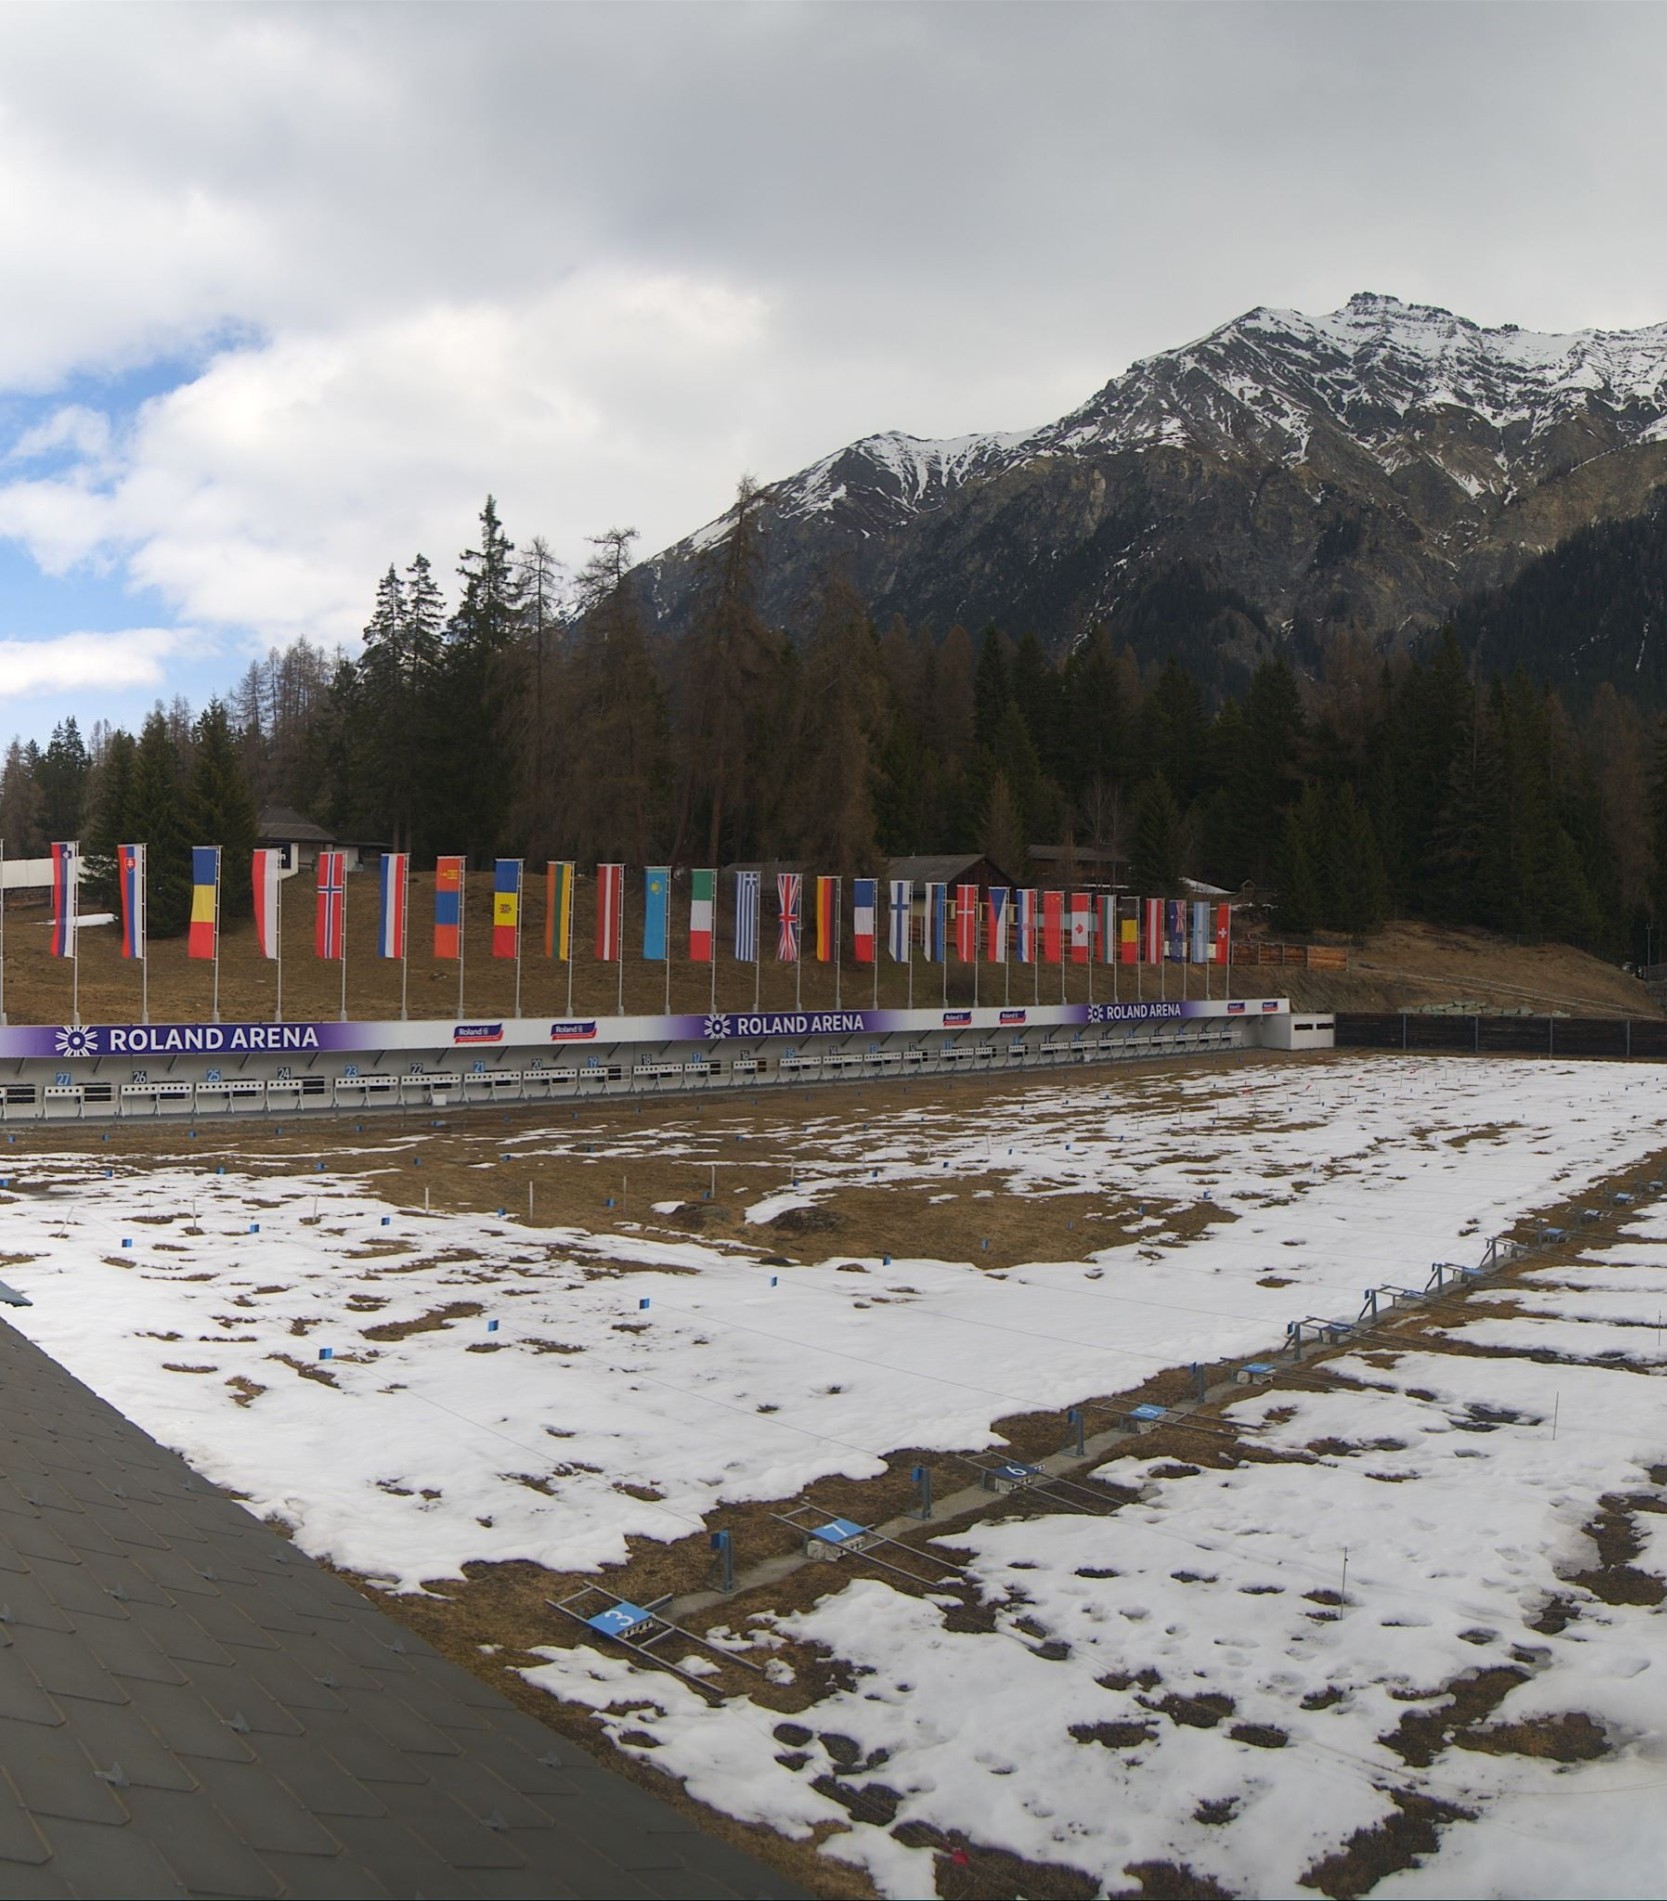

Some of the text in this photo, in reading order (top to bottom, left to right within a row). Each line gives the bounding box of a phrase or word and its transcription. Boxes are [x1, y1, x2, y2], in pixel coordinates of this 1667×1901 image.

[1106, 1004, 1181, 1020] ROLAND ARENA
[459, 1026, 482, 1036] Roland
[556, 1024, 578, 1033] Roland
[738, 1015, 864, 1035] ROLAND ARENA
[110, 1026, 320, 1052] ROLAND ARENA
[411, 1064, 422, 1074] 22
[474, 1062, 486, 1072] 21
[532, 1060, 542, 1070] 20
[588, 1058, 598, 1068] 19
[208, 1070, 220, 1082] 25
[278, 1068, 290, 1080] 24
[346, 1066, 358, 1076] 23
[56, 1072, 70, 1086] 27
[133, 1072, 146, 1084] 26
[604, 1608, 634, 1627] 3
